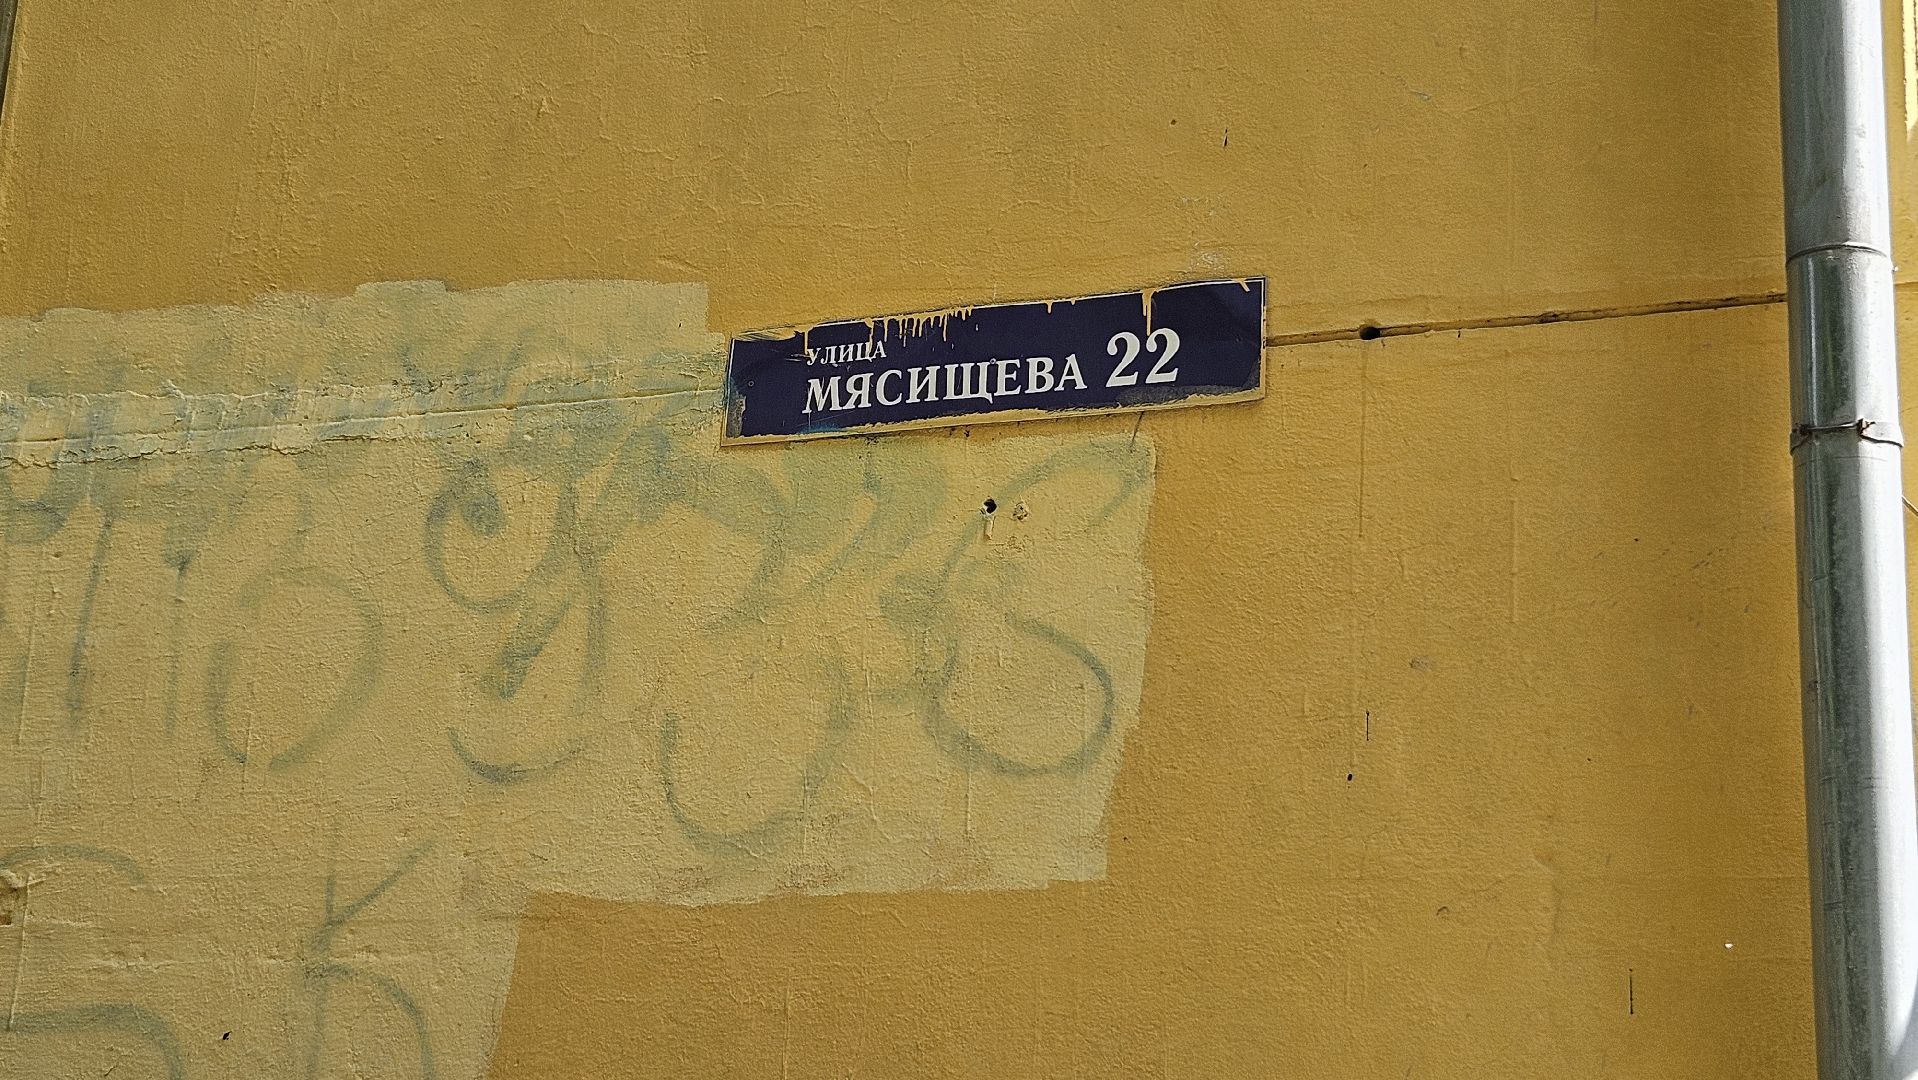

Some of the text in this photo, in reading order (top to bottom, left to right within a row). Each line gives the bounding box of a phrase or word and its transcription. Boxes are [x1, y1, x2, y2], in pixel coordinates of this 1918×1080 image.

[802, 327, 1180, 414] МЯСИЩЕВА 22
[806, 340, 887, 366] УЛИЦА
